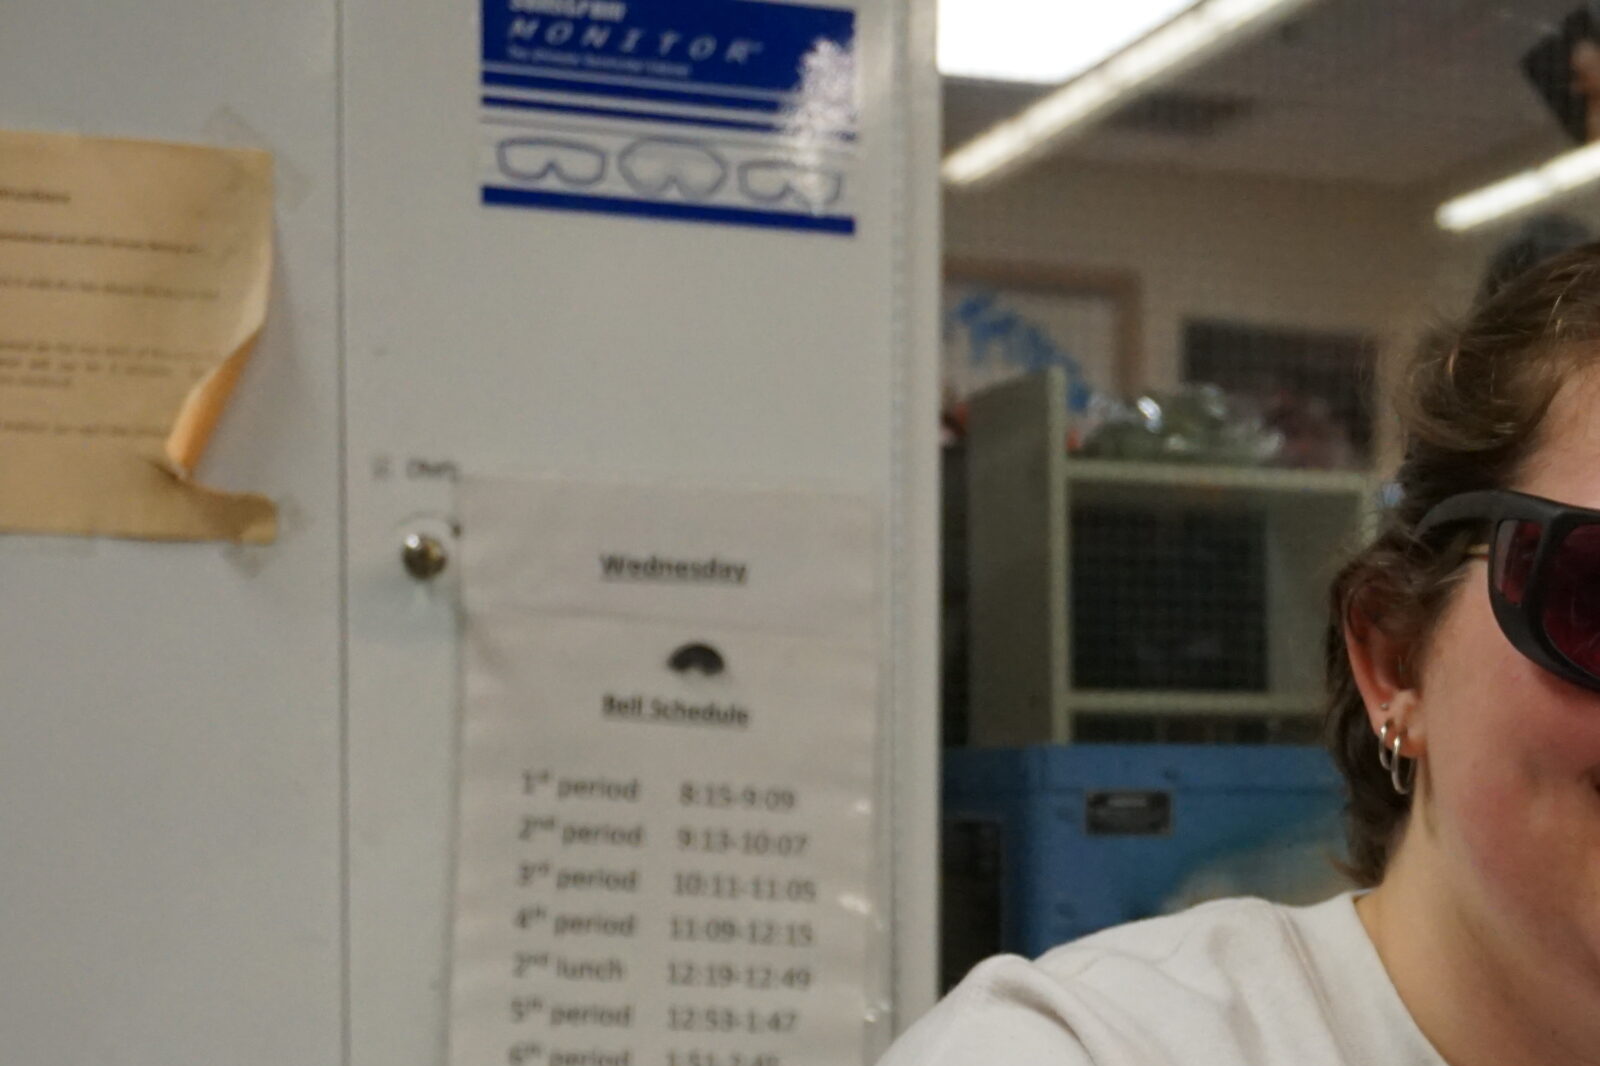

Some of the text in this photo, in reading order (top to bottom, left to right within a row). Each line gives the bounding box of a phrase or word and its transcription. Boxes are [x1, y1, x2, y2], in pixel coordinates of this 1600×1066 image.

[600, 553, 748, 586] Wednesday
[602, 693, 750, 730] Bell Schedule
[557, 776, 640, 803] period
[562, 822, 644, 848] period
[556, 867, 638, 893] period
[554, 913, 636, 938] period
[556, 956, 624, 983] lunch
[550, 1003, 632, 1029] period
